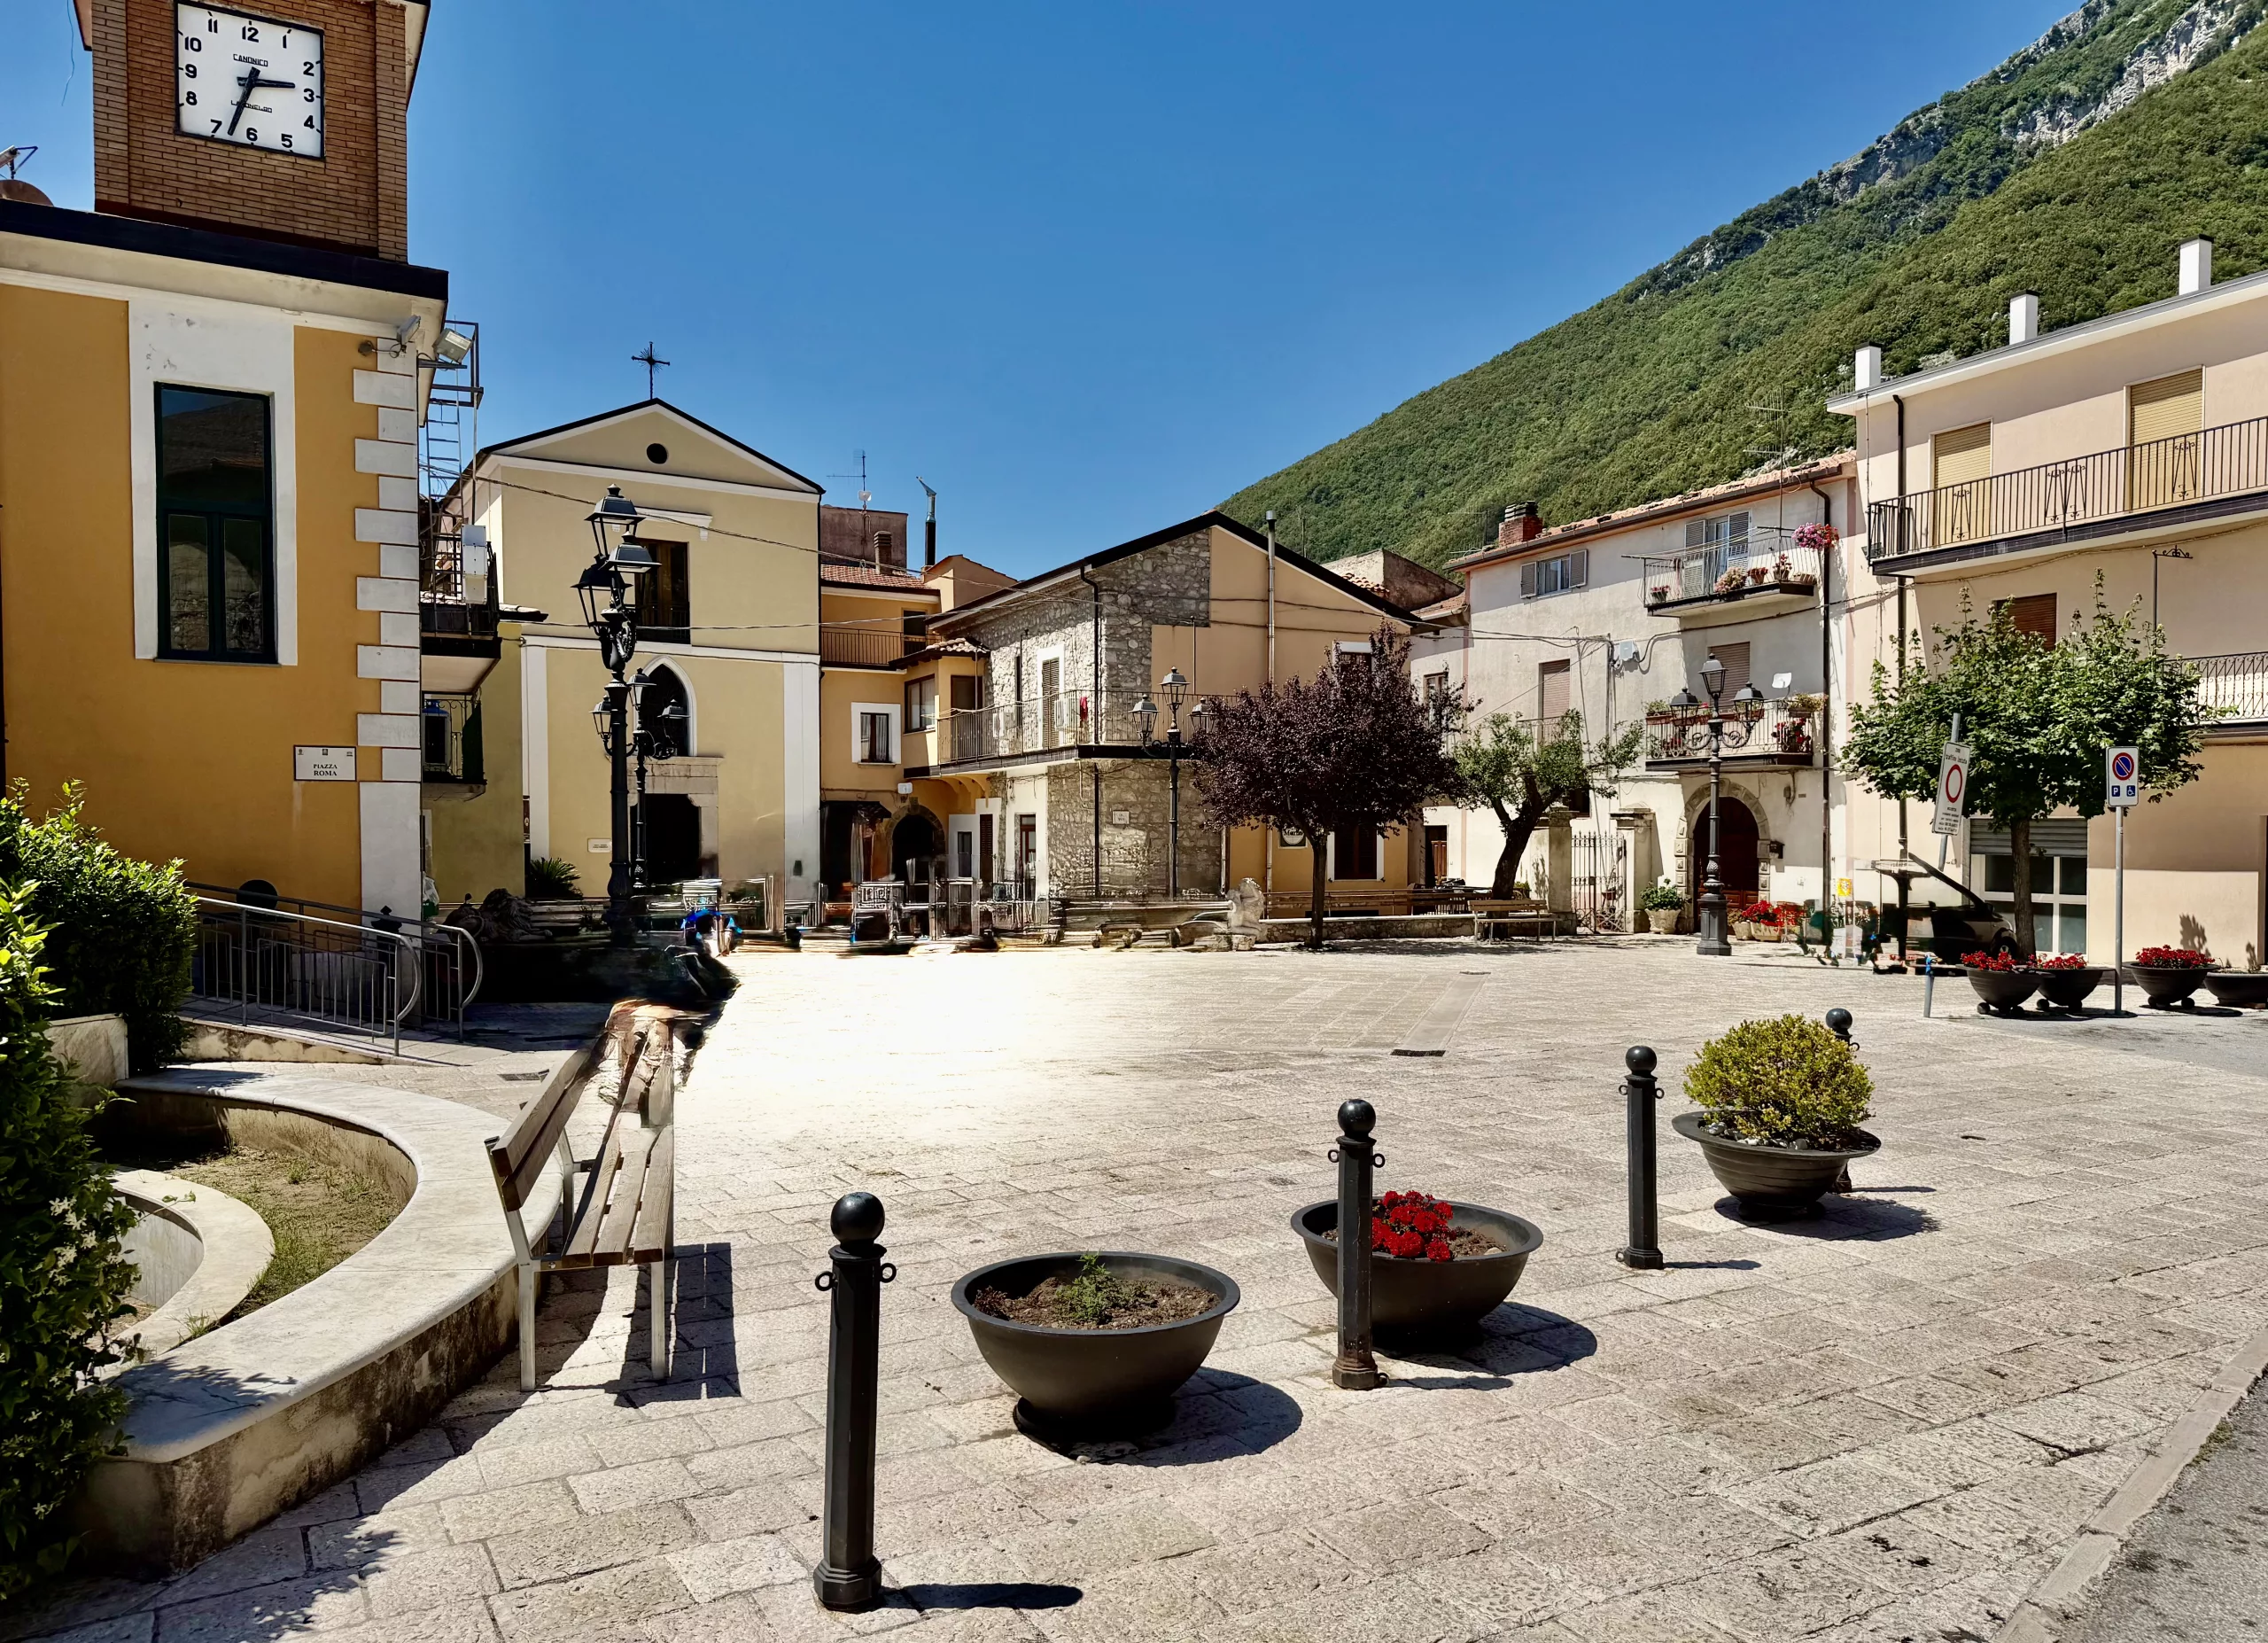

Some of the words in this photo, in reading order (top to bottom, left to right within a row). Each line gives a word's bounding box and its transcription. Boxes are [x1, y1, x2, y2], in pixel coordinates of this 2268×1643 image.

[208, 19, 218, 34] 11
[242, 26, 260, 43] 12
[282, 35, 287, 49] 1
[184, 36, 202, 52] 10
[233, 53, 268, 67] CANONICO
[184, 64, 198, 79] 9
[303, 61, 315, 76] 2
[185, 91, 198, 106] 8
[303, 88, 315, 103] 3
[230, 99, 273, 113] LONEGRO
[210, 119, 222, 134] 7
[303, 115, 315, 129] 4
[245, 128, 258, 142] 6
[281, 133, 293, 149] 5
